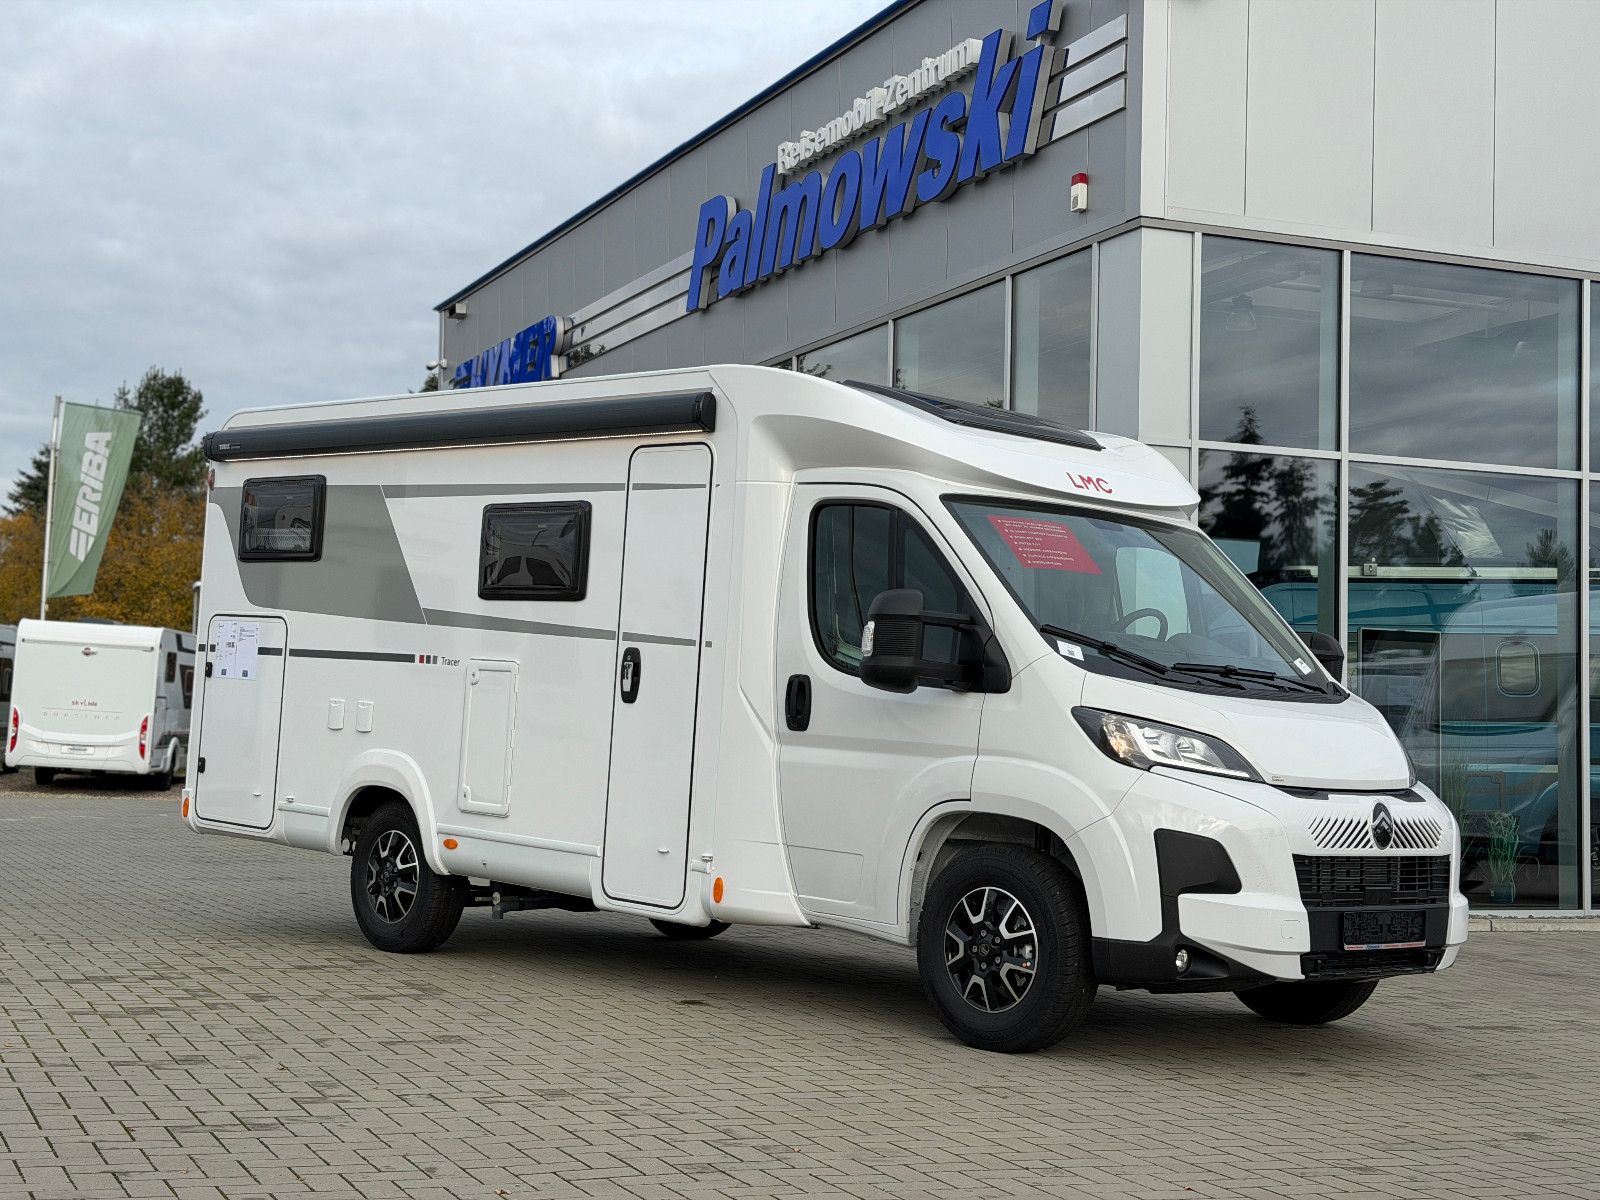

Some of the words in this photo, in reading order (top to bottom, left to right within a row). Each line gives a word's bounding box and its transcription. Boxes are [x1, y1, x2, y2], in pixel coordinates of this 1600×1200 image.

[686, 0, 1056, 312] Palmowski
[776, 38, 983, 175] Reisemobil-Zentrum
[71, 432, 112, 541] ERIBA
[1066, 471, 1113, 494] LMC
[441, 656, 460, 667] Tracer
